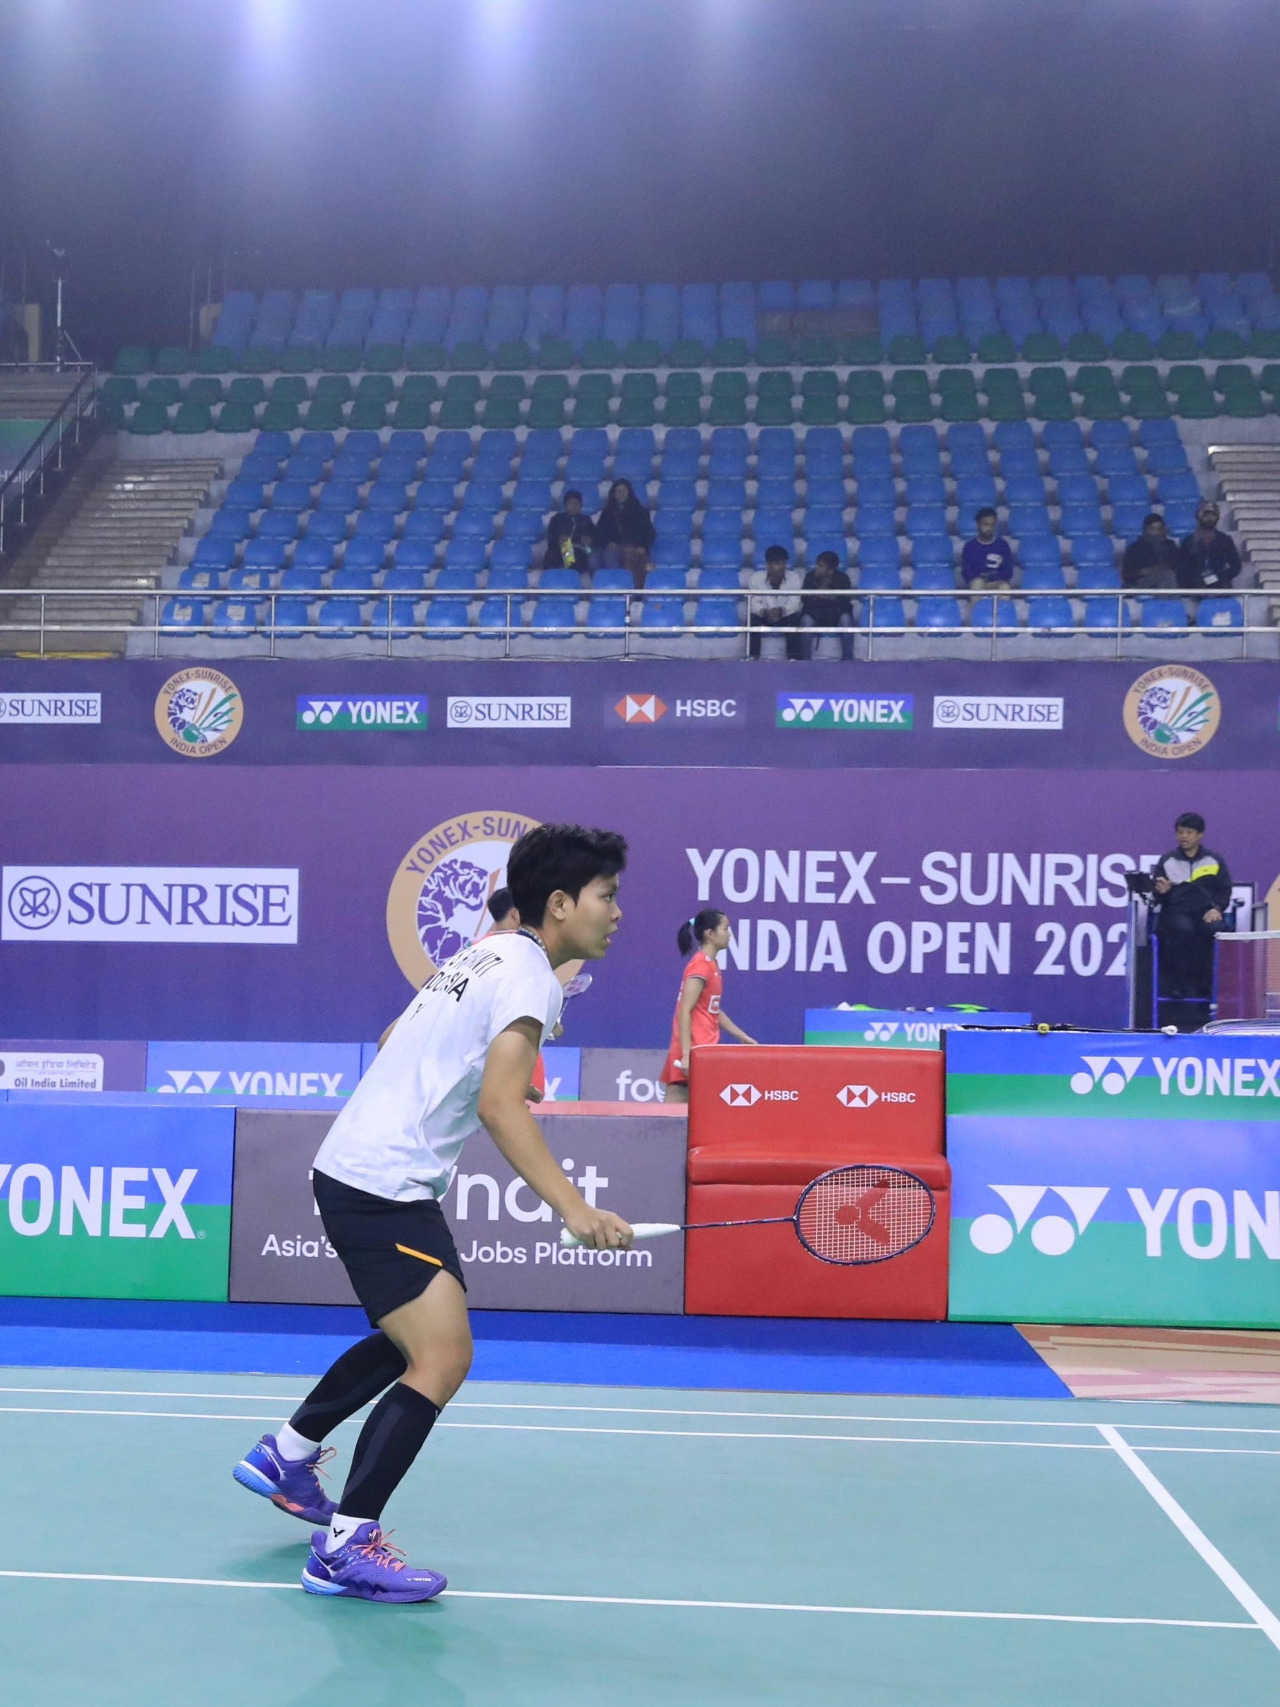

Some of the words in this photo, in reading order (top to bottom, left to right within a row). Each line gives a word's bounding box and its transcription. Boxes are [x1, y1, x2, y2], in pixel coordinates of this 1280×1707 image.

[163, 669, 234, 695] YONEX-SUNRISE
[8, 699, 99, 718] SUNRISE
[347, 700, 420, 724] YONEX
[474, 702, 569, 722] SUNRISE
[675, 699, 737, 718] HSBC
[829, 699, 906, 724] YONEX
[961, 702, 1060, 722] SUNRISE
[170, 737, 196, 754] INDIA
[199, 737, 227, 754] OPEN
[67, 880, 293, 928] SUNRISE
[867, 920, 1011, 975] OPEN
[14, 1077, 28, 1088] Oil
[31, 1077, 57, 1088] India
[60, 1078, 97, 1089] Limited
[229, 1070, 343, 1097] YONEX
[1152, 1056, 1280, 1097] YONEX
[764, 1090, 799, 1101] HSBC
[880, 1091, 916, 1103] HSBC
[1126, 1187, 1280, 1260] YON
[261, 1233, 337, 1259] Asia's
[460, 1239, 528, 1265] Jobs
